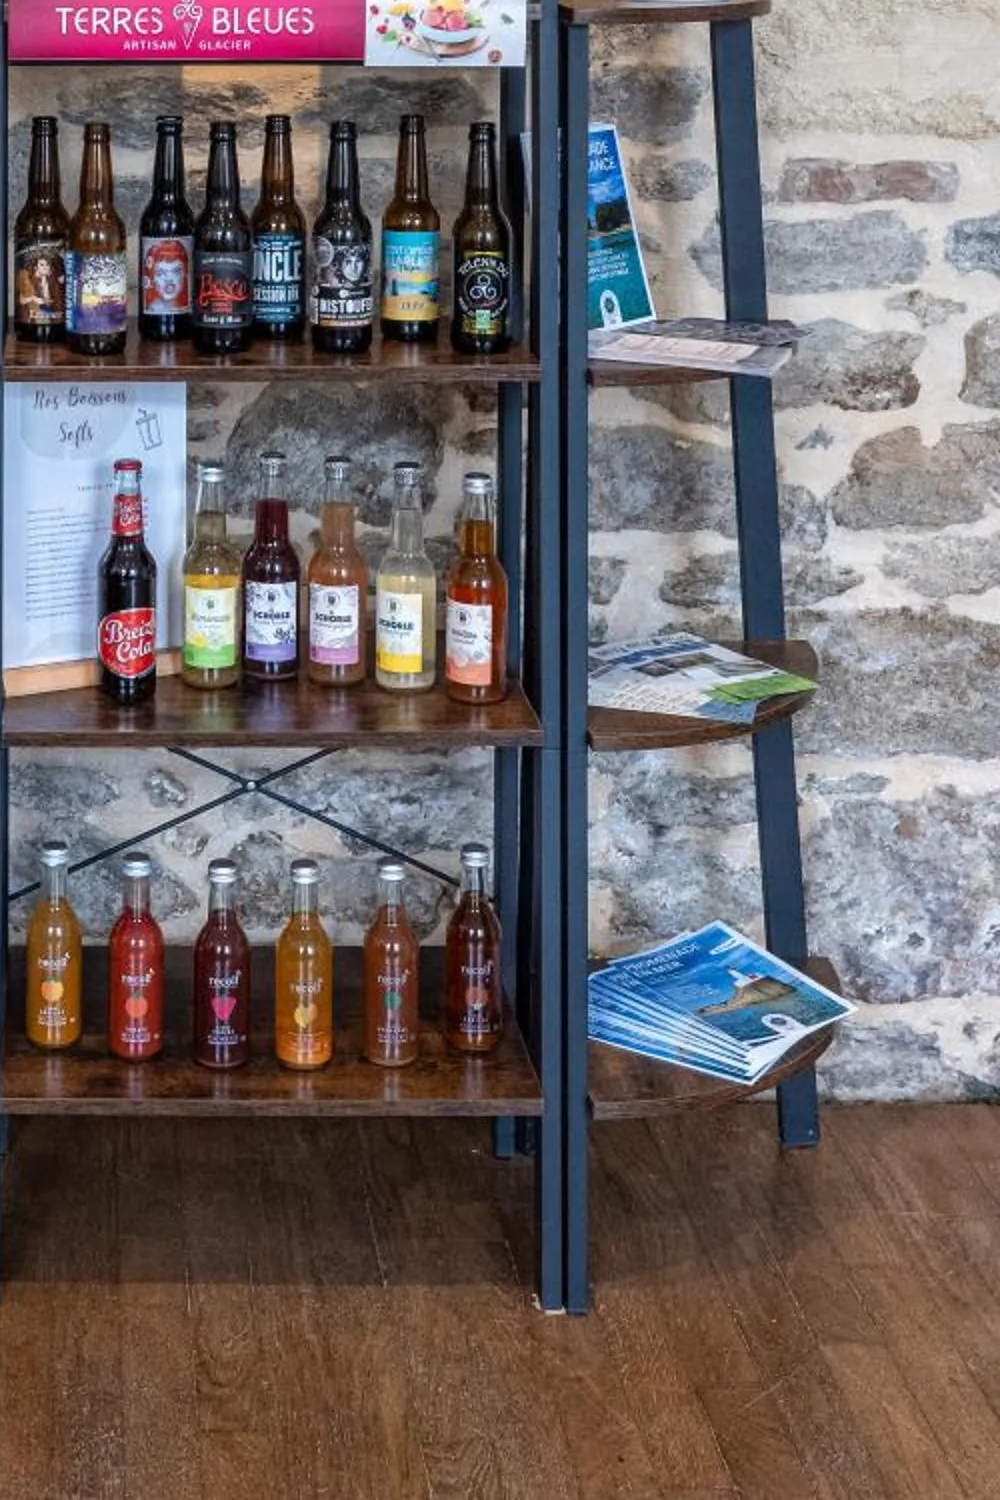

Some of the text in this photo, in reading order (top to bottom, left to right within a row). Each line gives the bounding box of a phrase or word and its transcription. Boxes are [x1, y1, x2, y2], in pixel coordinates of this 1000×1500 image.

[55, 7, 315, 35] TERRES BLEUES
[123, 40, 251, 50] ARTISAN GLACIER
[34, 390, 60, 411] Nos
[59, 419, 93, 449] Softs
[116, 638, 153, 663] Cola
